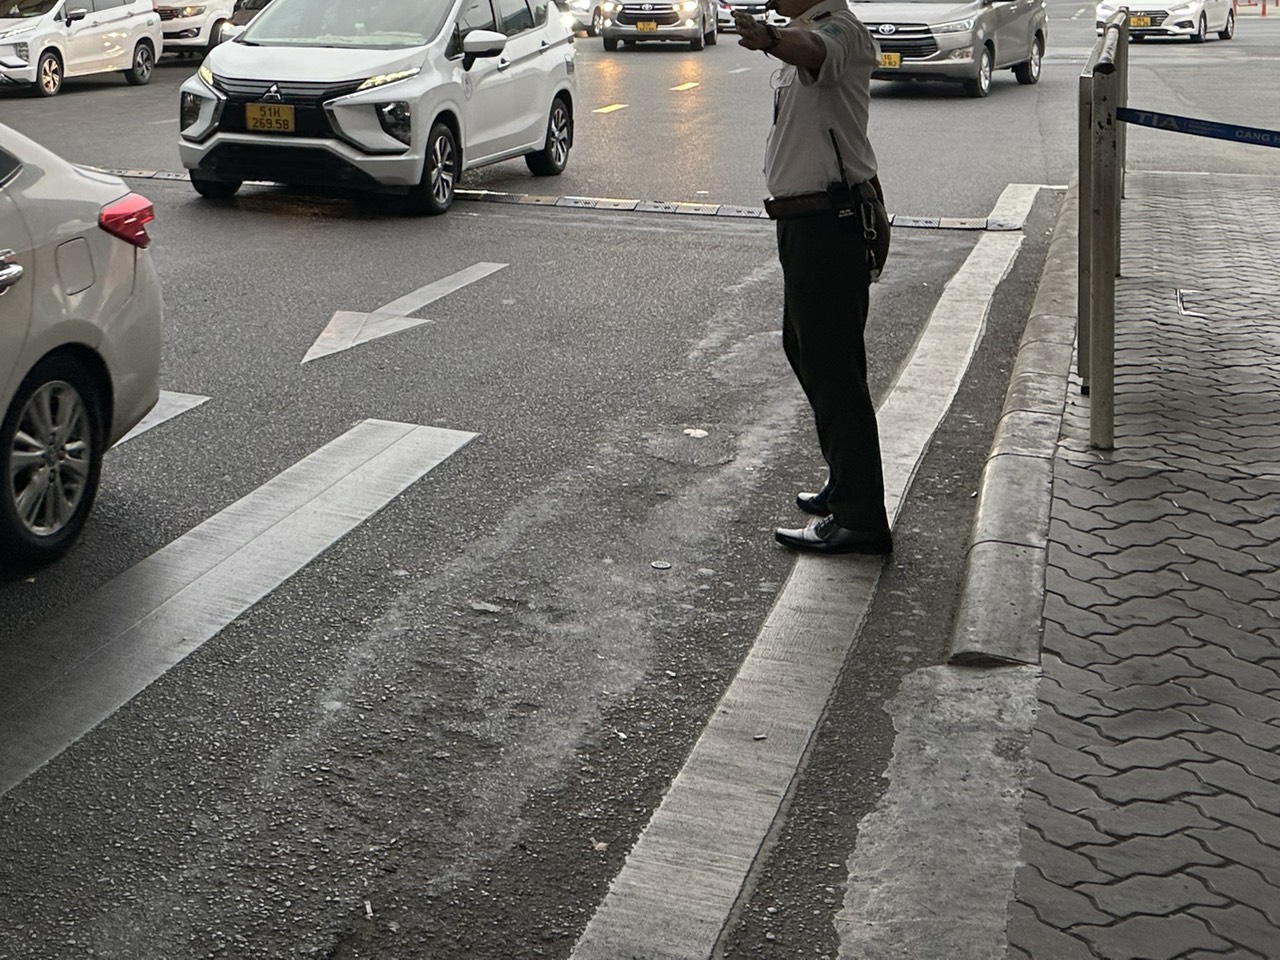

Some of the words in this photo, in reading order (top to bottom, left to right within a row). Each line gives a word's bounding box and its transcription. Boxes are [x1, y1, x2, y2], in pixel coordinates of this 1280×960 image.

[260, 106, 280, 118] 51H
[252, 118, 290, 130] 269.58
[1135, 111, 1180, 131] TIA
